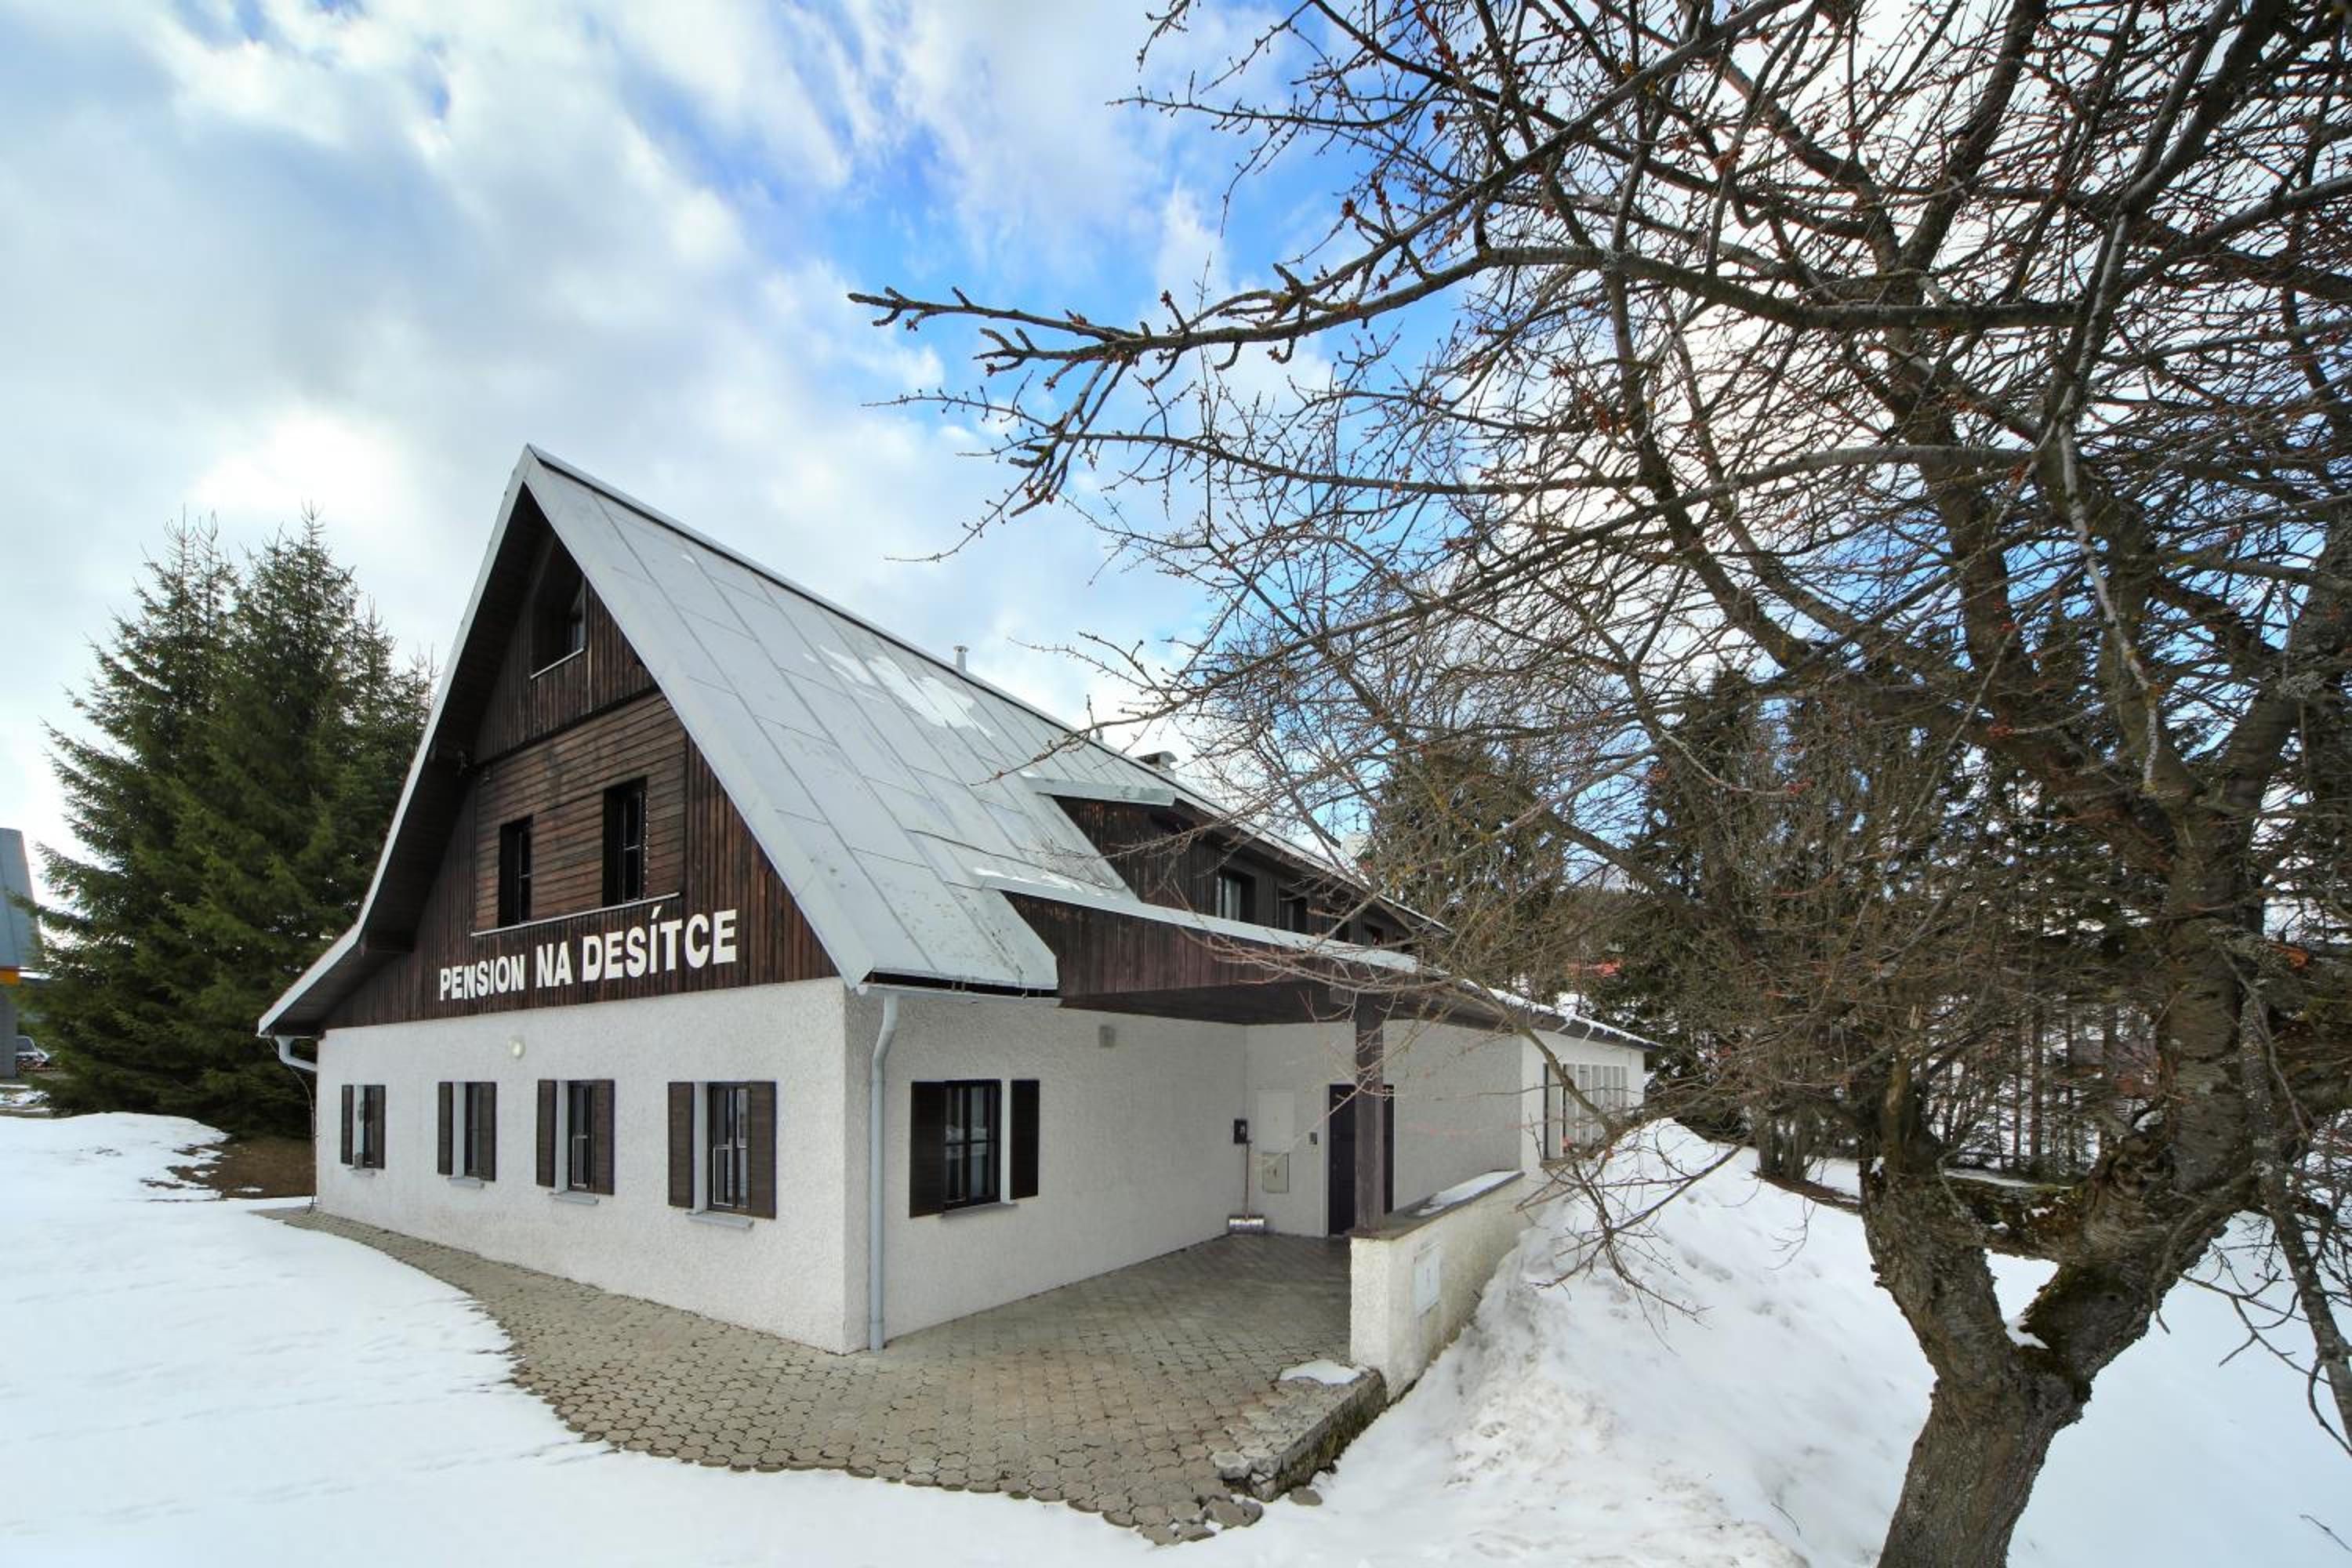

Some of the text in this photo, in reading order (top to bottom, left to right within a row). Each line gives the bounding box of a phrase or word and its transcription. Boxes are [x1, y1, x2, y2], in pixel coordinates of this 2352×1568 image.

[440, 906, 737, 1001] PENSION NA DESÍTCE
